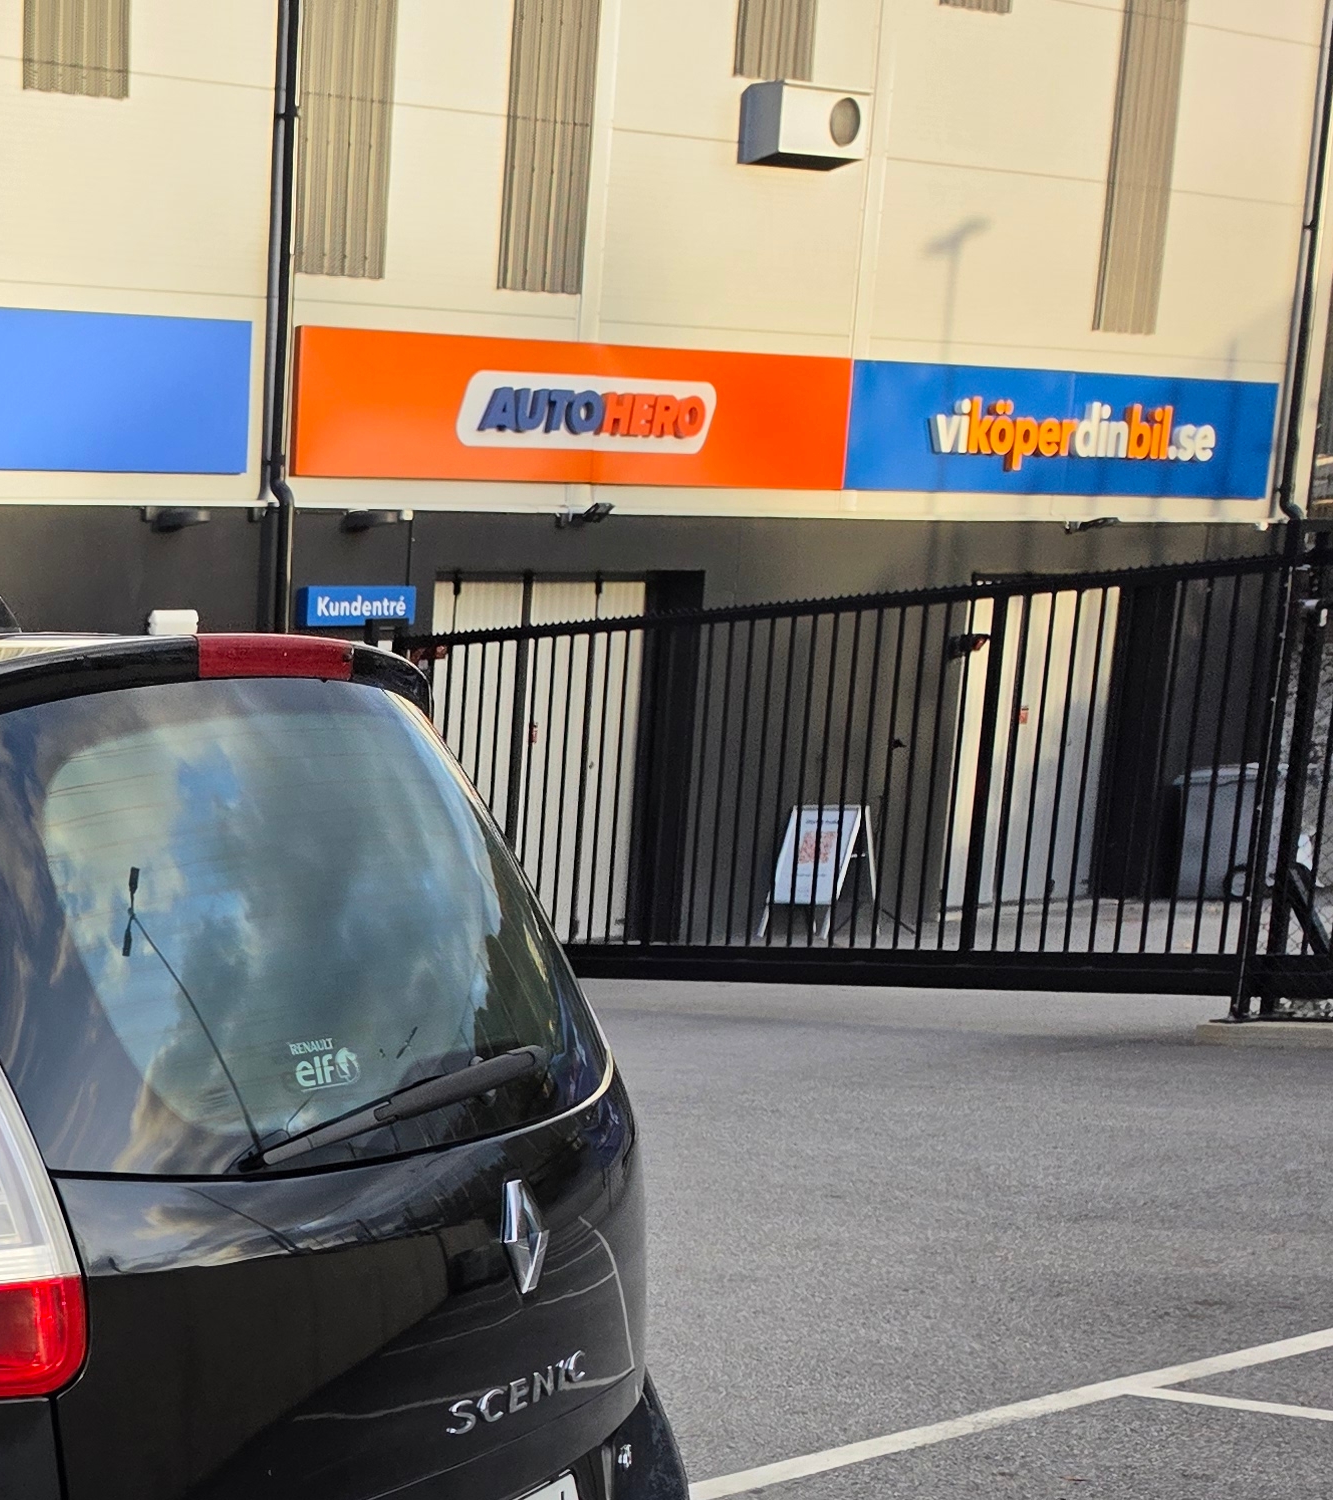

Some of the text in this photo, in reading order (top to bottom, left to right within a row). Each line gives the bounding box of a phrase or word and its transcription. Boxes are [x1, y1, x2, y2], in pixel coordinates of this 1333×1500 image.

[476, 386, 707, 439] AUTOHERO
[928, 395, 1217, 471] viköperdinbil.se
[316, 595, 407, 617] Kundentré
[287, 1038, 334, 1056] RENAULT
[295, 1053, 335, 1087] elf
[445, 1350, 586, 1435] SCENIC
